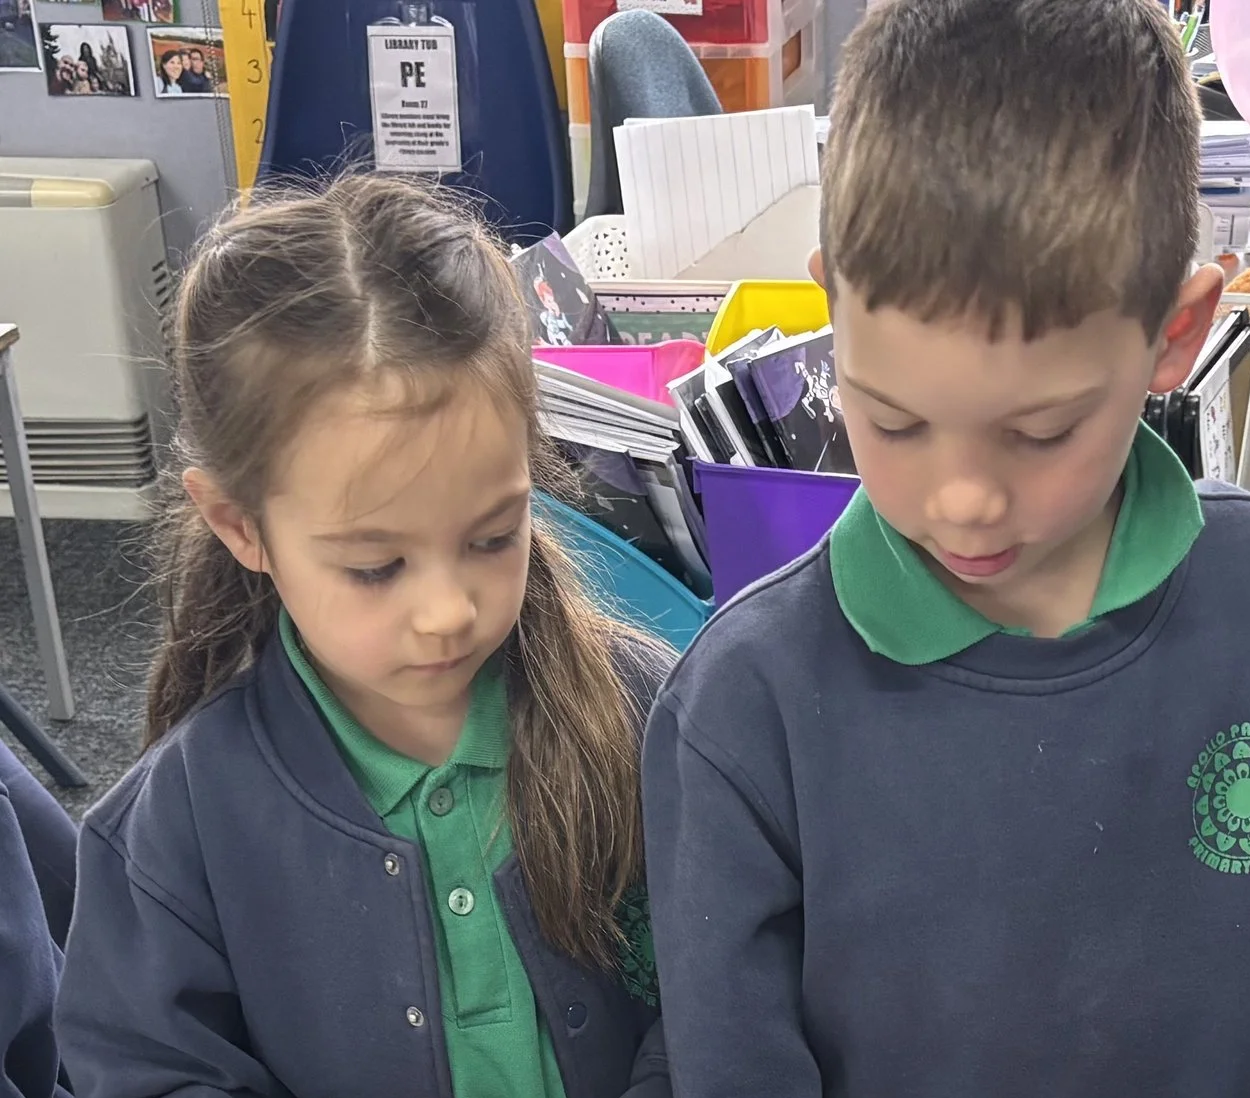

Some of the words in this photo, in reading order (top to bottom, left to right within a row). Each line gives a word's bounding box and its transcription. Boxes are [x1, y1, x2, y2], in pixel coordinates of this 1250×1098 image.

[384, 38, 419, 50] LIBRARY
[247, 59, 263, 84] 3
[400, 61, 426, 88] PE
[252, 118, 264, 144] 2
[1187, 731, 1226, 788] APOLLO
